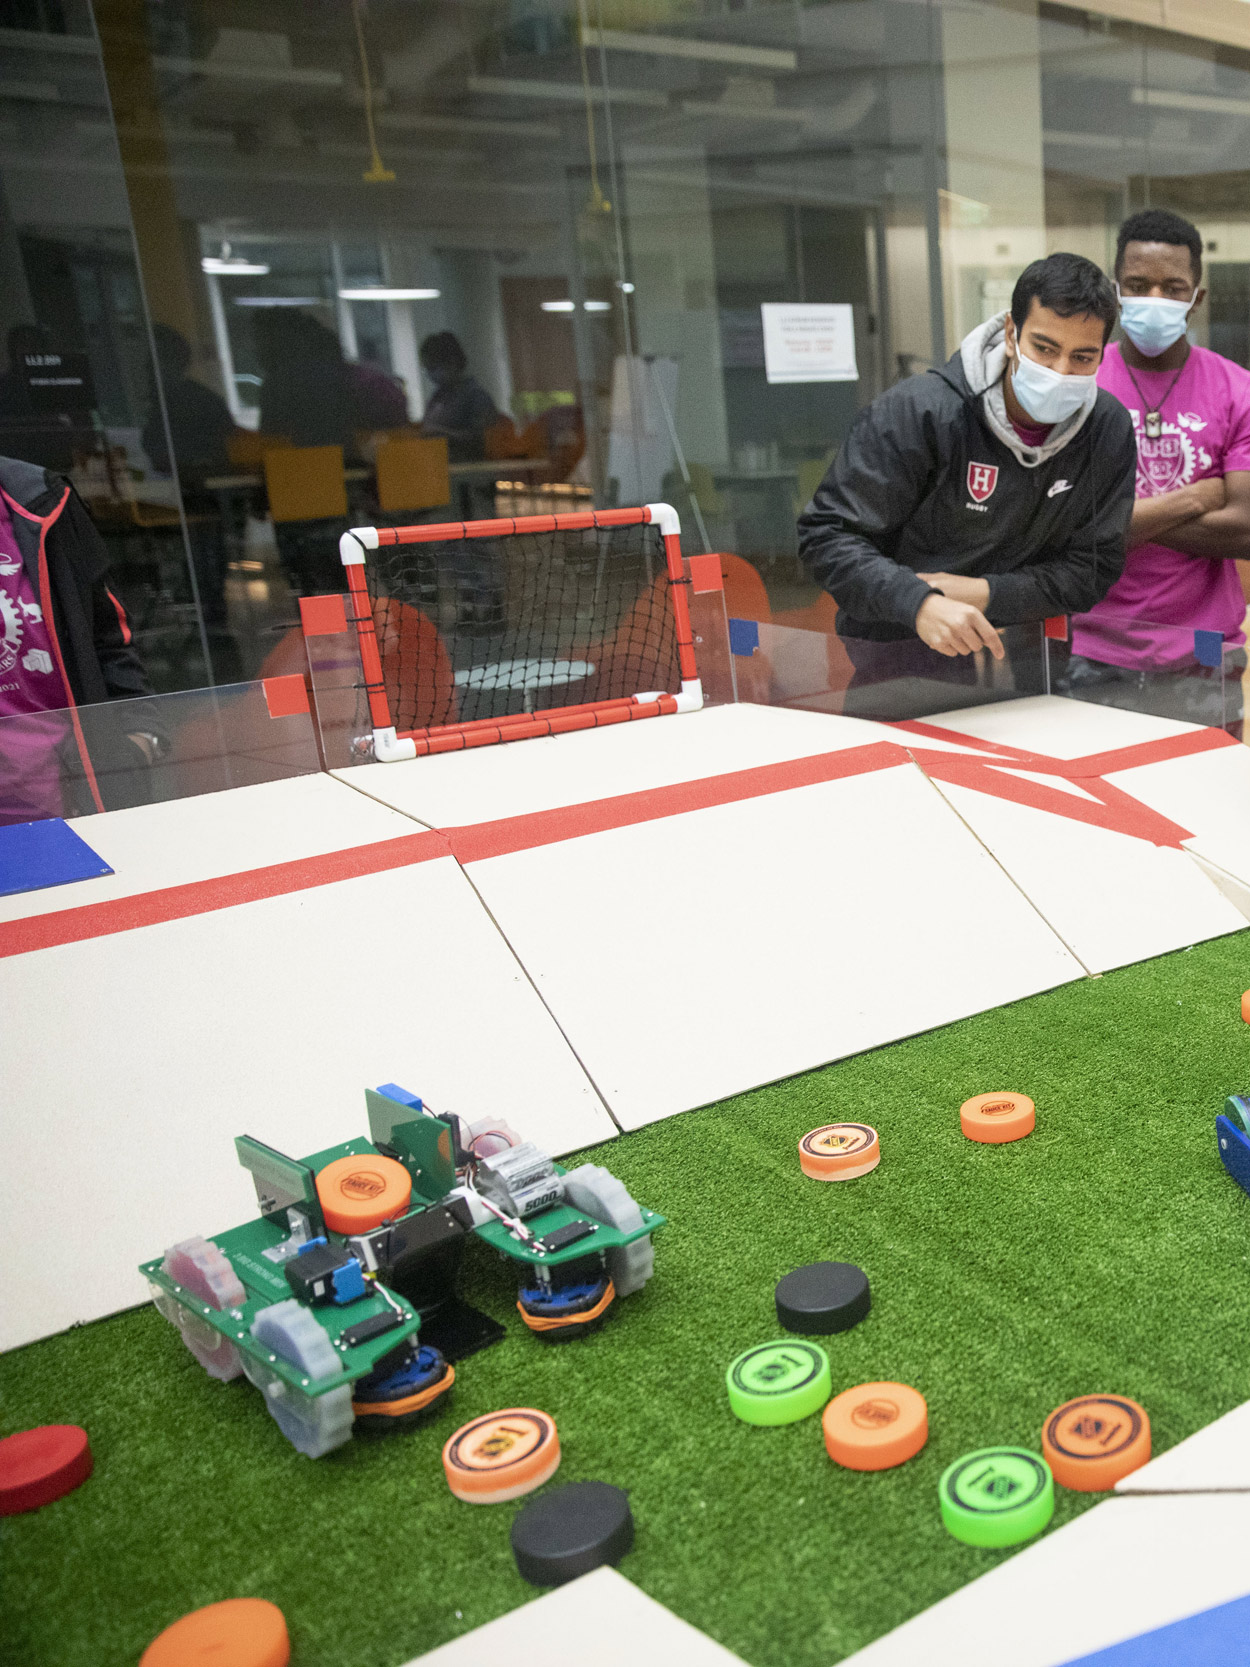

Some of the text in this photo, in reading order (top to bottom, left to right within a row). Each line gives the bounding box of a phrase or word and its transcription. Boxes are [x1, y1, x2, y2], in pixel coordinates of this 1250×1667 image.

[972, 467, 991, 492] H
[966, 501, 989, 512] RUGBY
[525, 1190, 557, 1213] 5000
